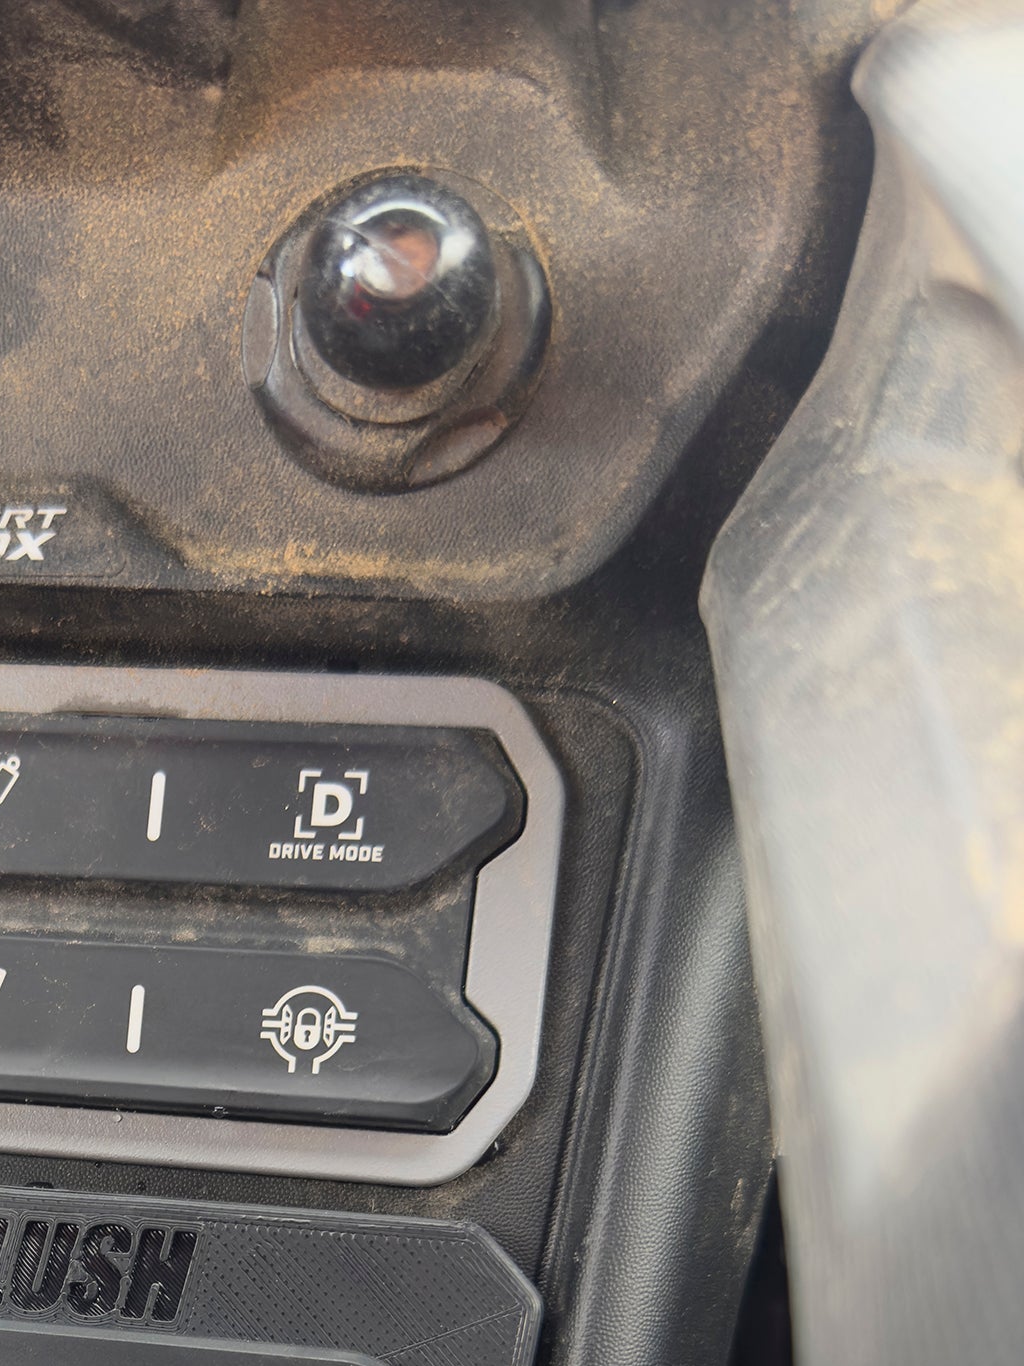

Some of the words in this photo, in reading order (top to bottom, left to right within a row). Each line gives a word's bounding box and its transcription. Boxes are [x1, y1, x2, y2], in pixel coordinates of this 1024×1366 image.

[310, 782, 353, 827] D
[268, 842, 325, 860] DRIVE
[328, 844, 384, 863] MODE
